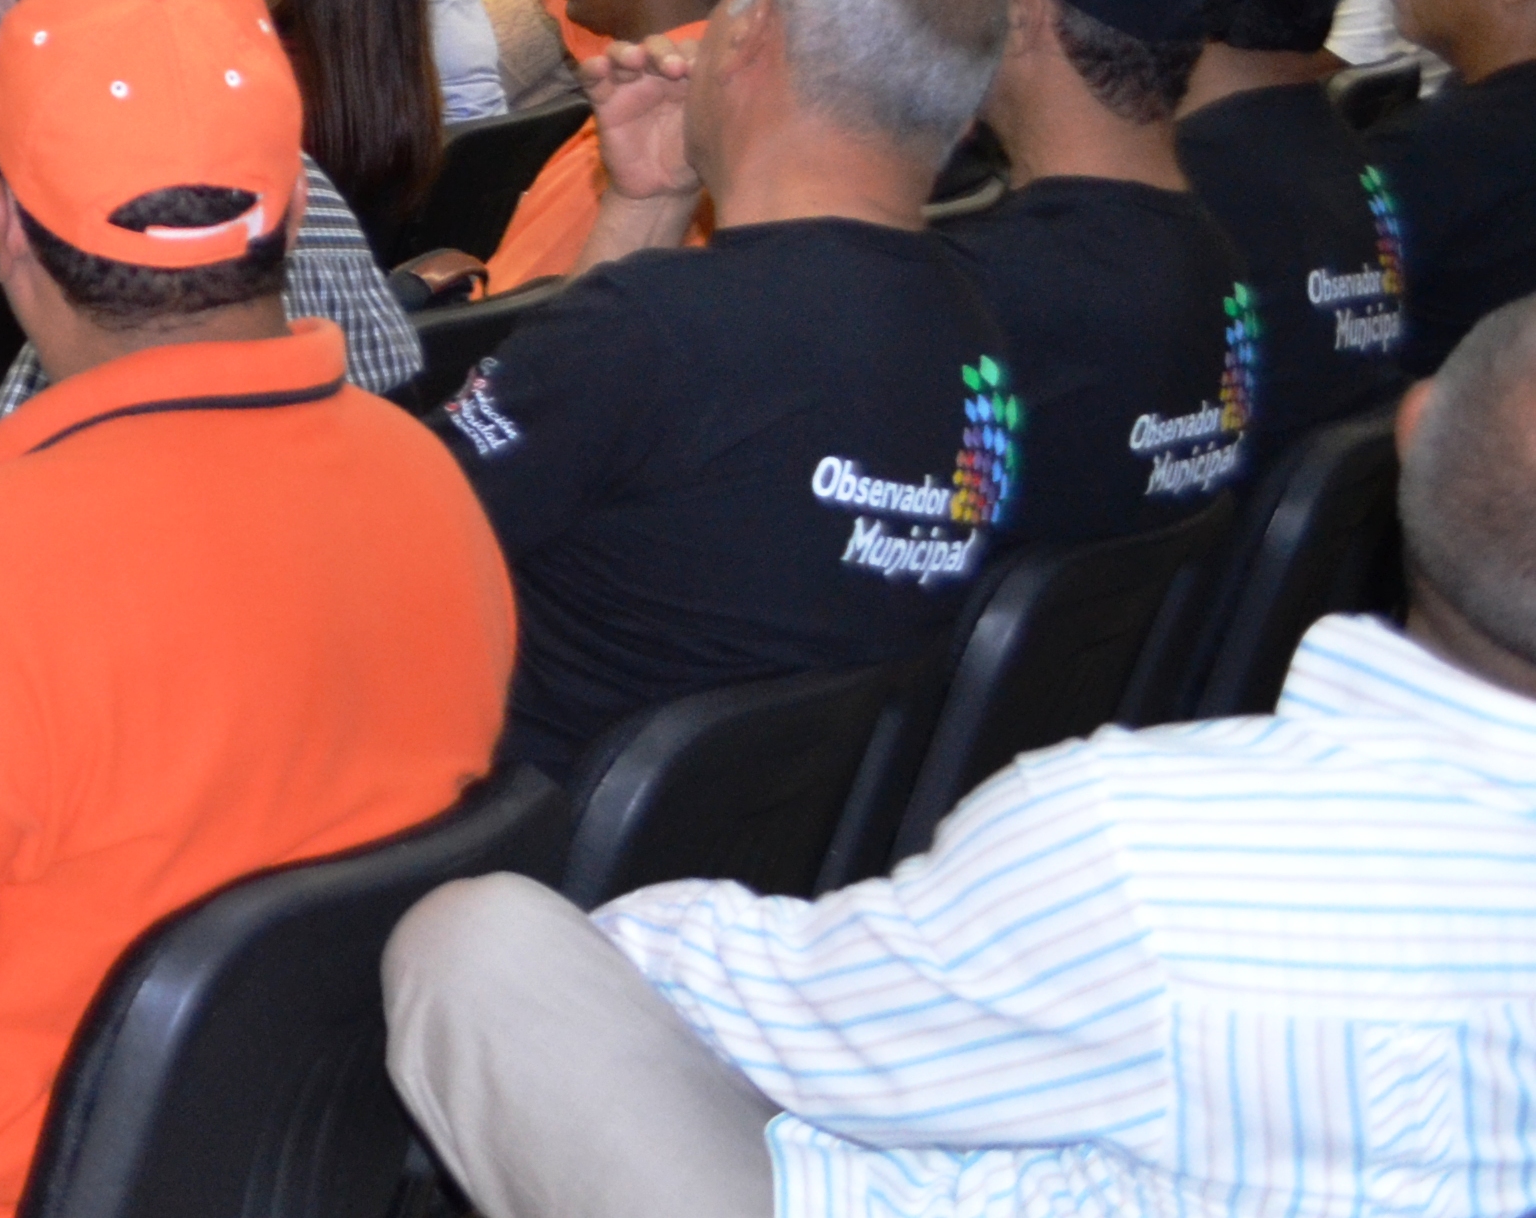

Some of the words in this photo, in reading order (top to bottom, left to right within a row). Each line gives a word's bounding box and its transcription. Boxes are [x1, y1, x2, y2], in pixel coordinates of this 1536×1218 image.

[1307, 262, 1383, 304] Observador
[1334, 304, 1402, 353] Municipal
[1129, 399, 1221, 451] Observador
[811, 455, 950, 515] Observador
[1144, 430, 1245, 496] Municipal
[839, 515, 977, 585] Municipal
